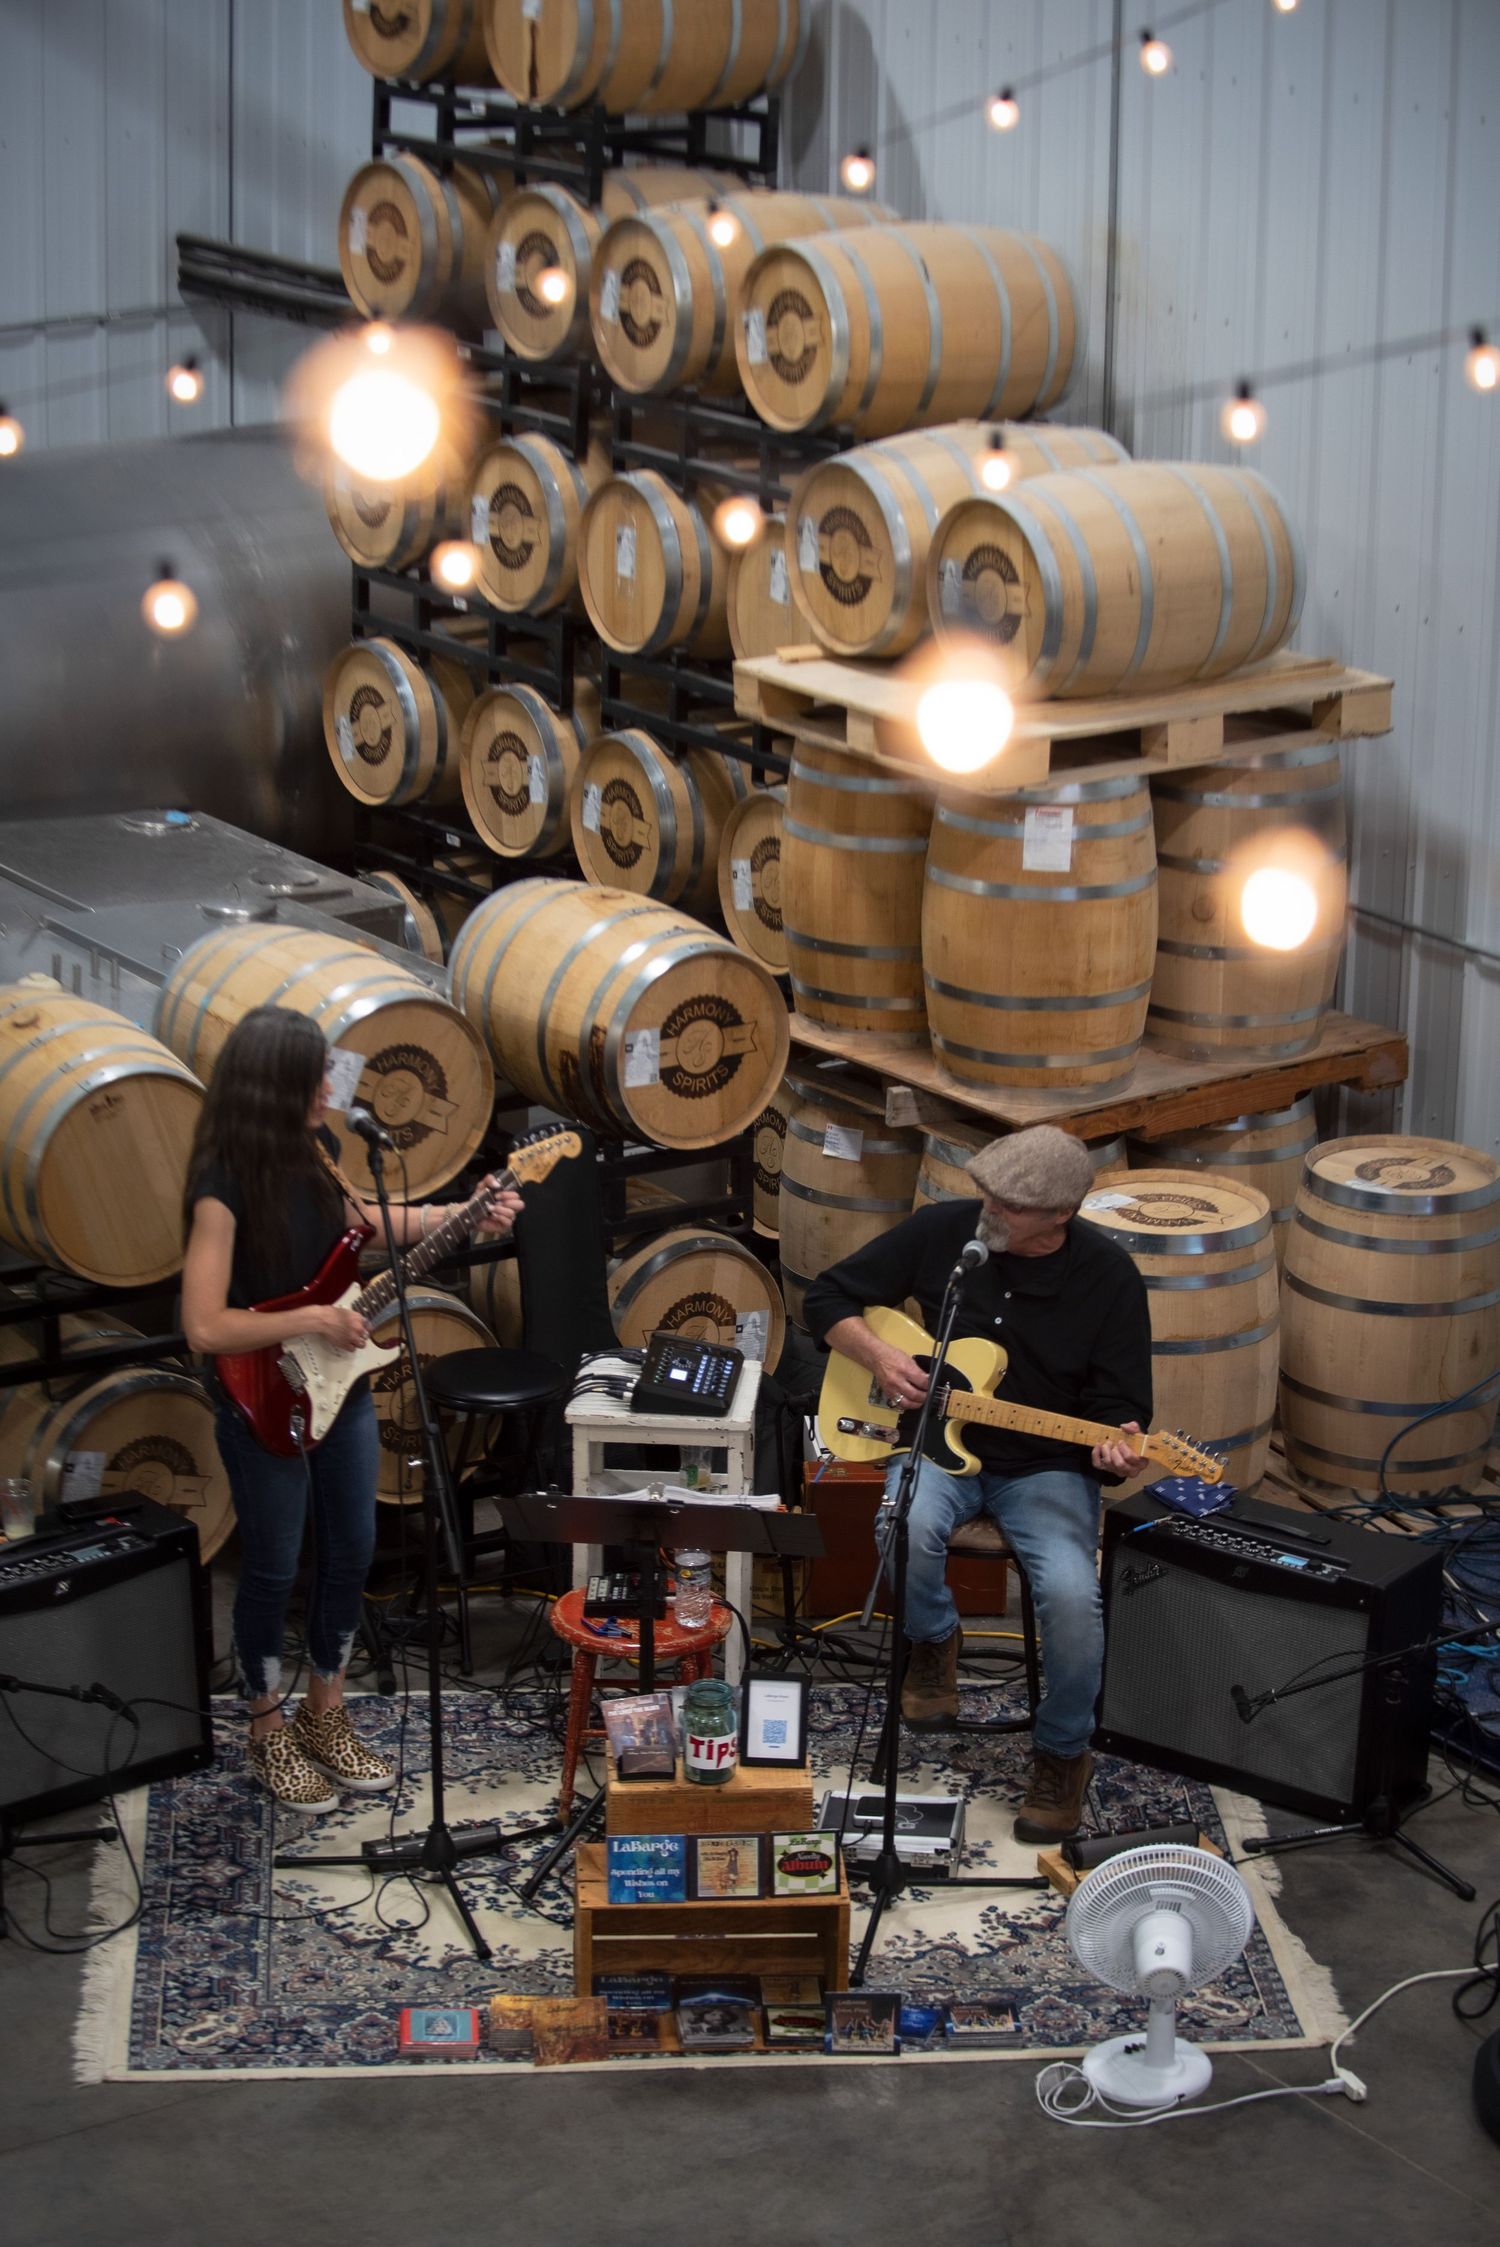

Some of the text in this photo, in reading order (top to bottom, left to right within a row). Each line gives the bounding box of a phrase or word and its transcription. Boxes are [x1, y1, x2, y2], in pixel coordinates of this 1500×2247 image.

[667, 1003, 734, 1036] HARMONY
[376, 1051, 442, 1091] HARMONY
[672, 1064, 728, 1092] SPIRITS
[753, 1113, 786, 1134] ARMONY
[667, 1301, 732, 1328] HARMONY
[613, 1840, 679, 1857] LaBarge
